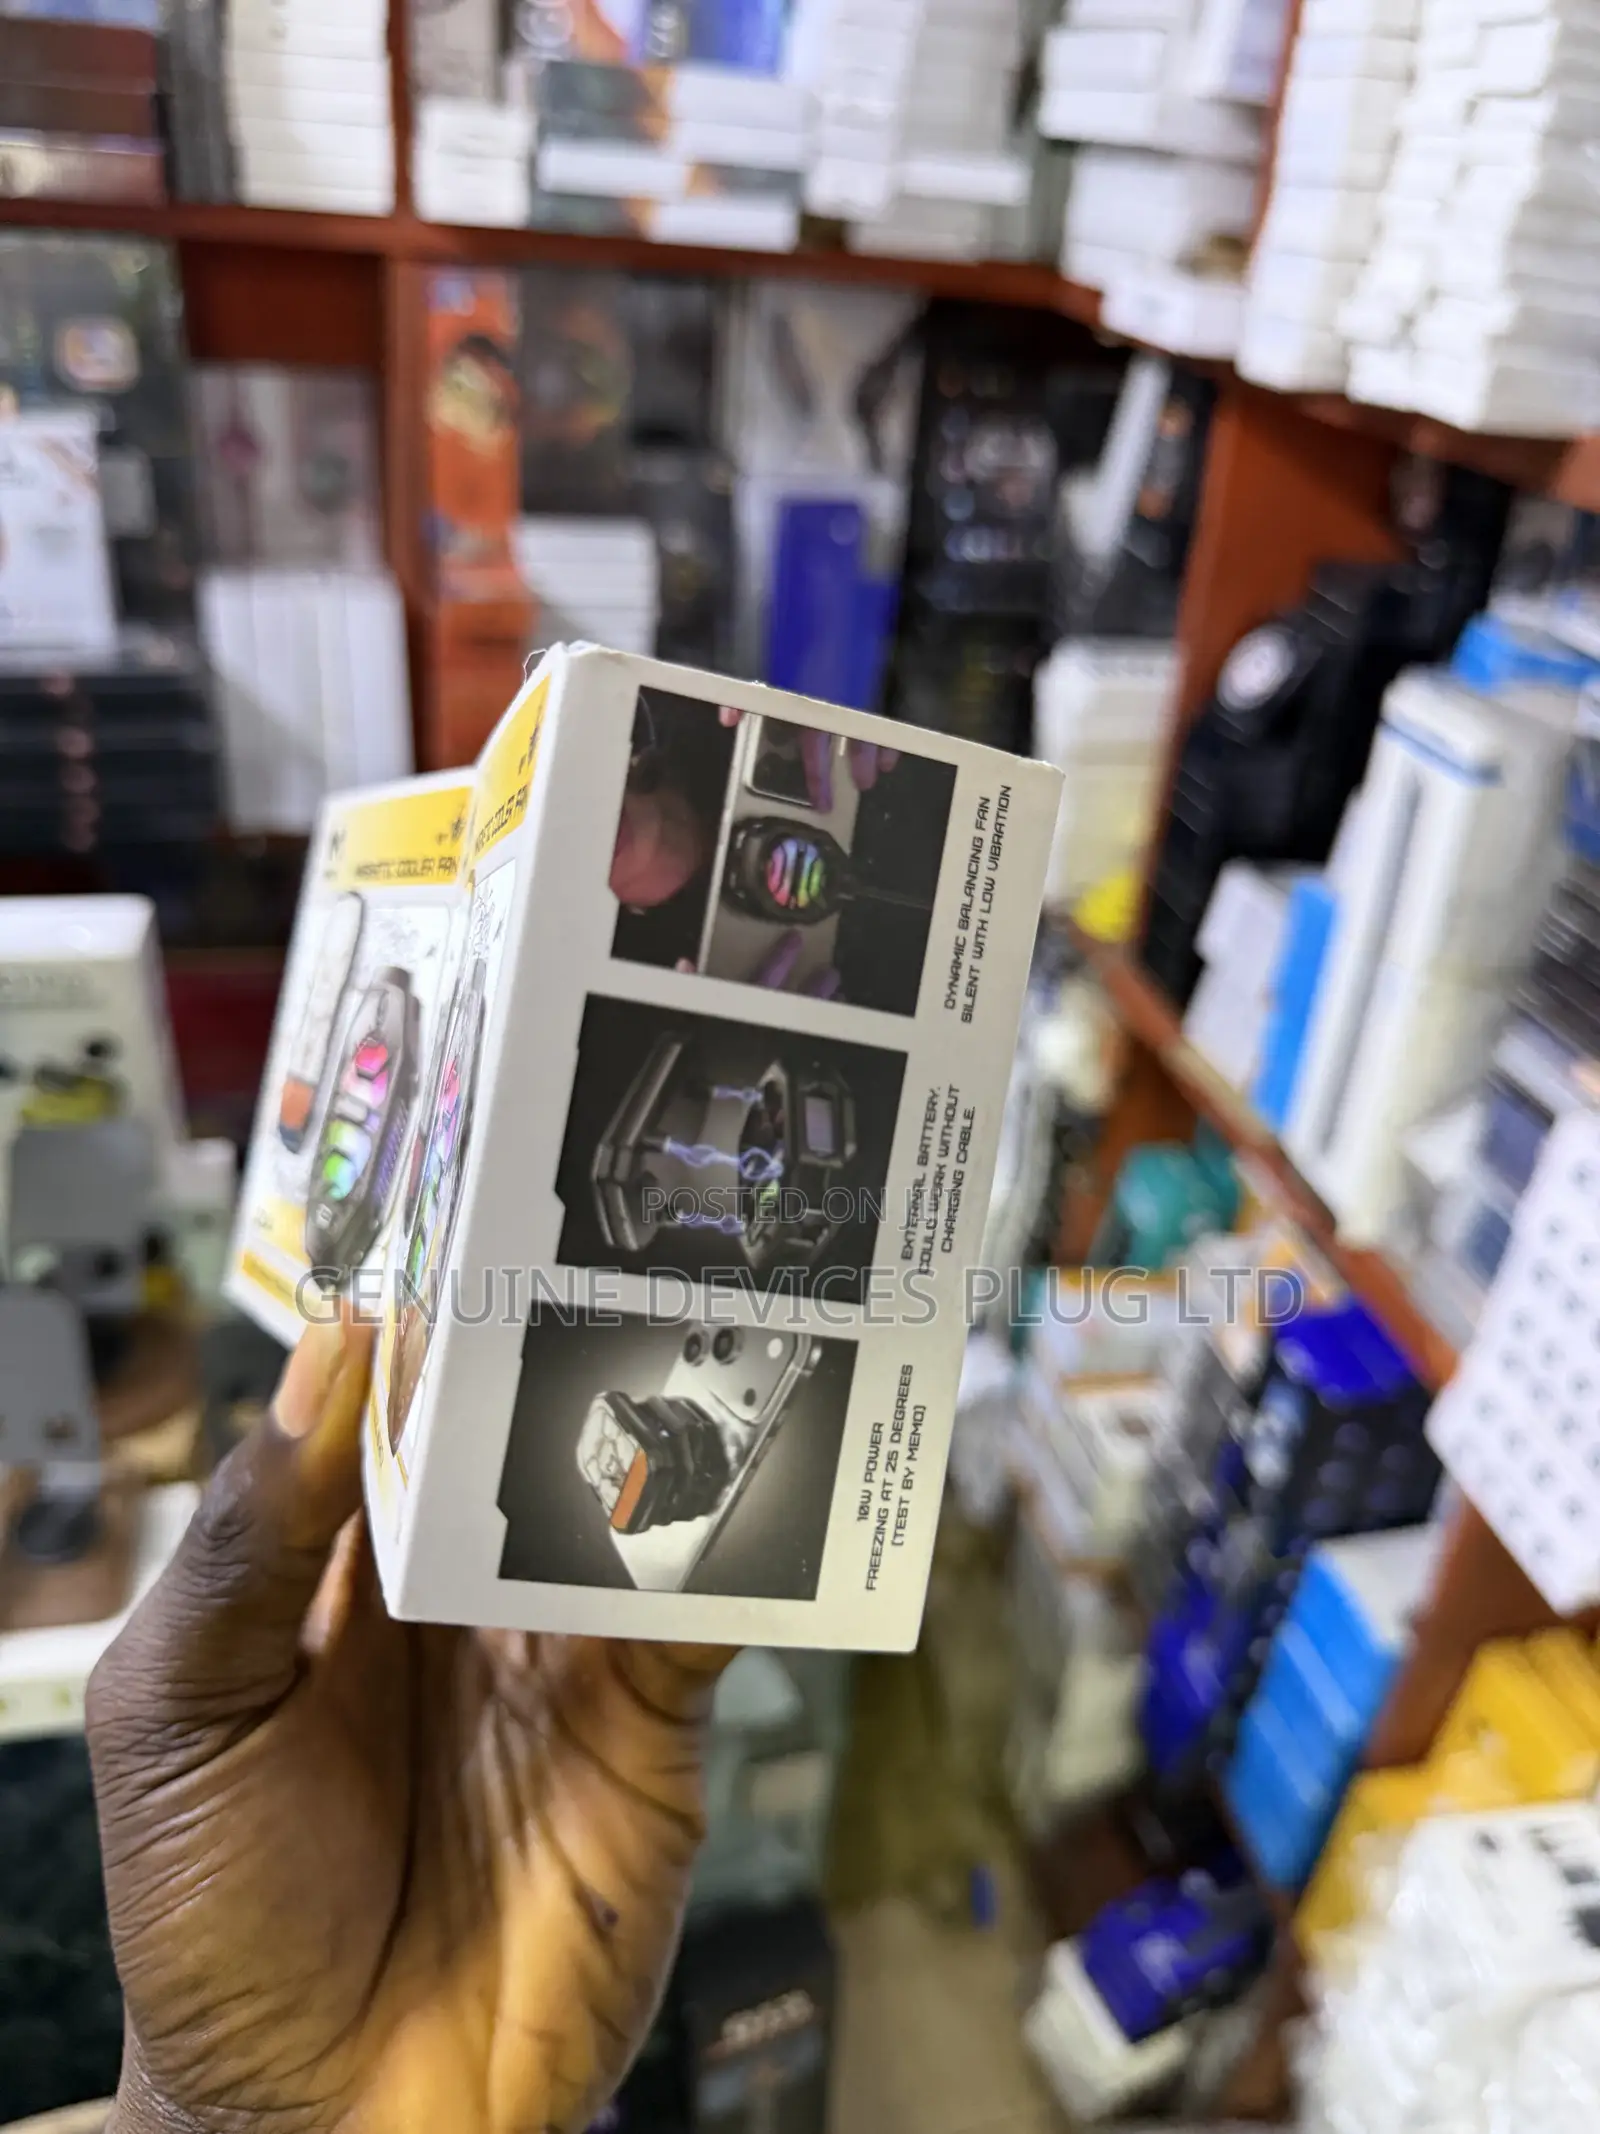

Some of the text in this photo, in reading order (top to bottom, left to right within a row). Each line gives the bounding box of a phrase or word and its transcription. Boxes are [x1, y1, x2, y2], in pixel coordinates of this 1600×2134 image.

[944, 795, 991, 1011] DYNAMIC BALANCING FAN
[960, 784, 1012, 1024] SILENT WITH LOW VIBRATION
[900, 1172, 926, 1261] EXTERNAL
[918, 1083, 960, 1275] COULD WORK WITHOUT
[941, 1105, 976, 1253] CHARGING CABLE.
[864, 1422, 884, 1483] POWER
[865, 1364, 913, 1591] FREEZING AT 25 DEGREES
[902, 1465, 915, 1490] BY
